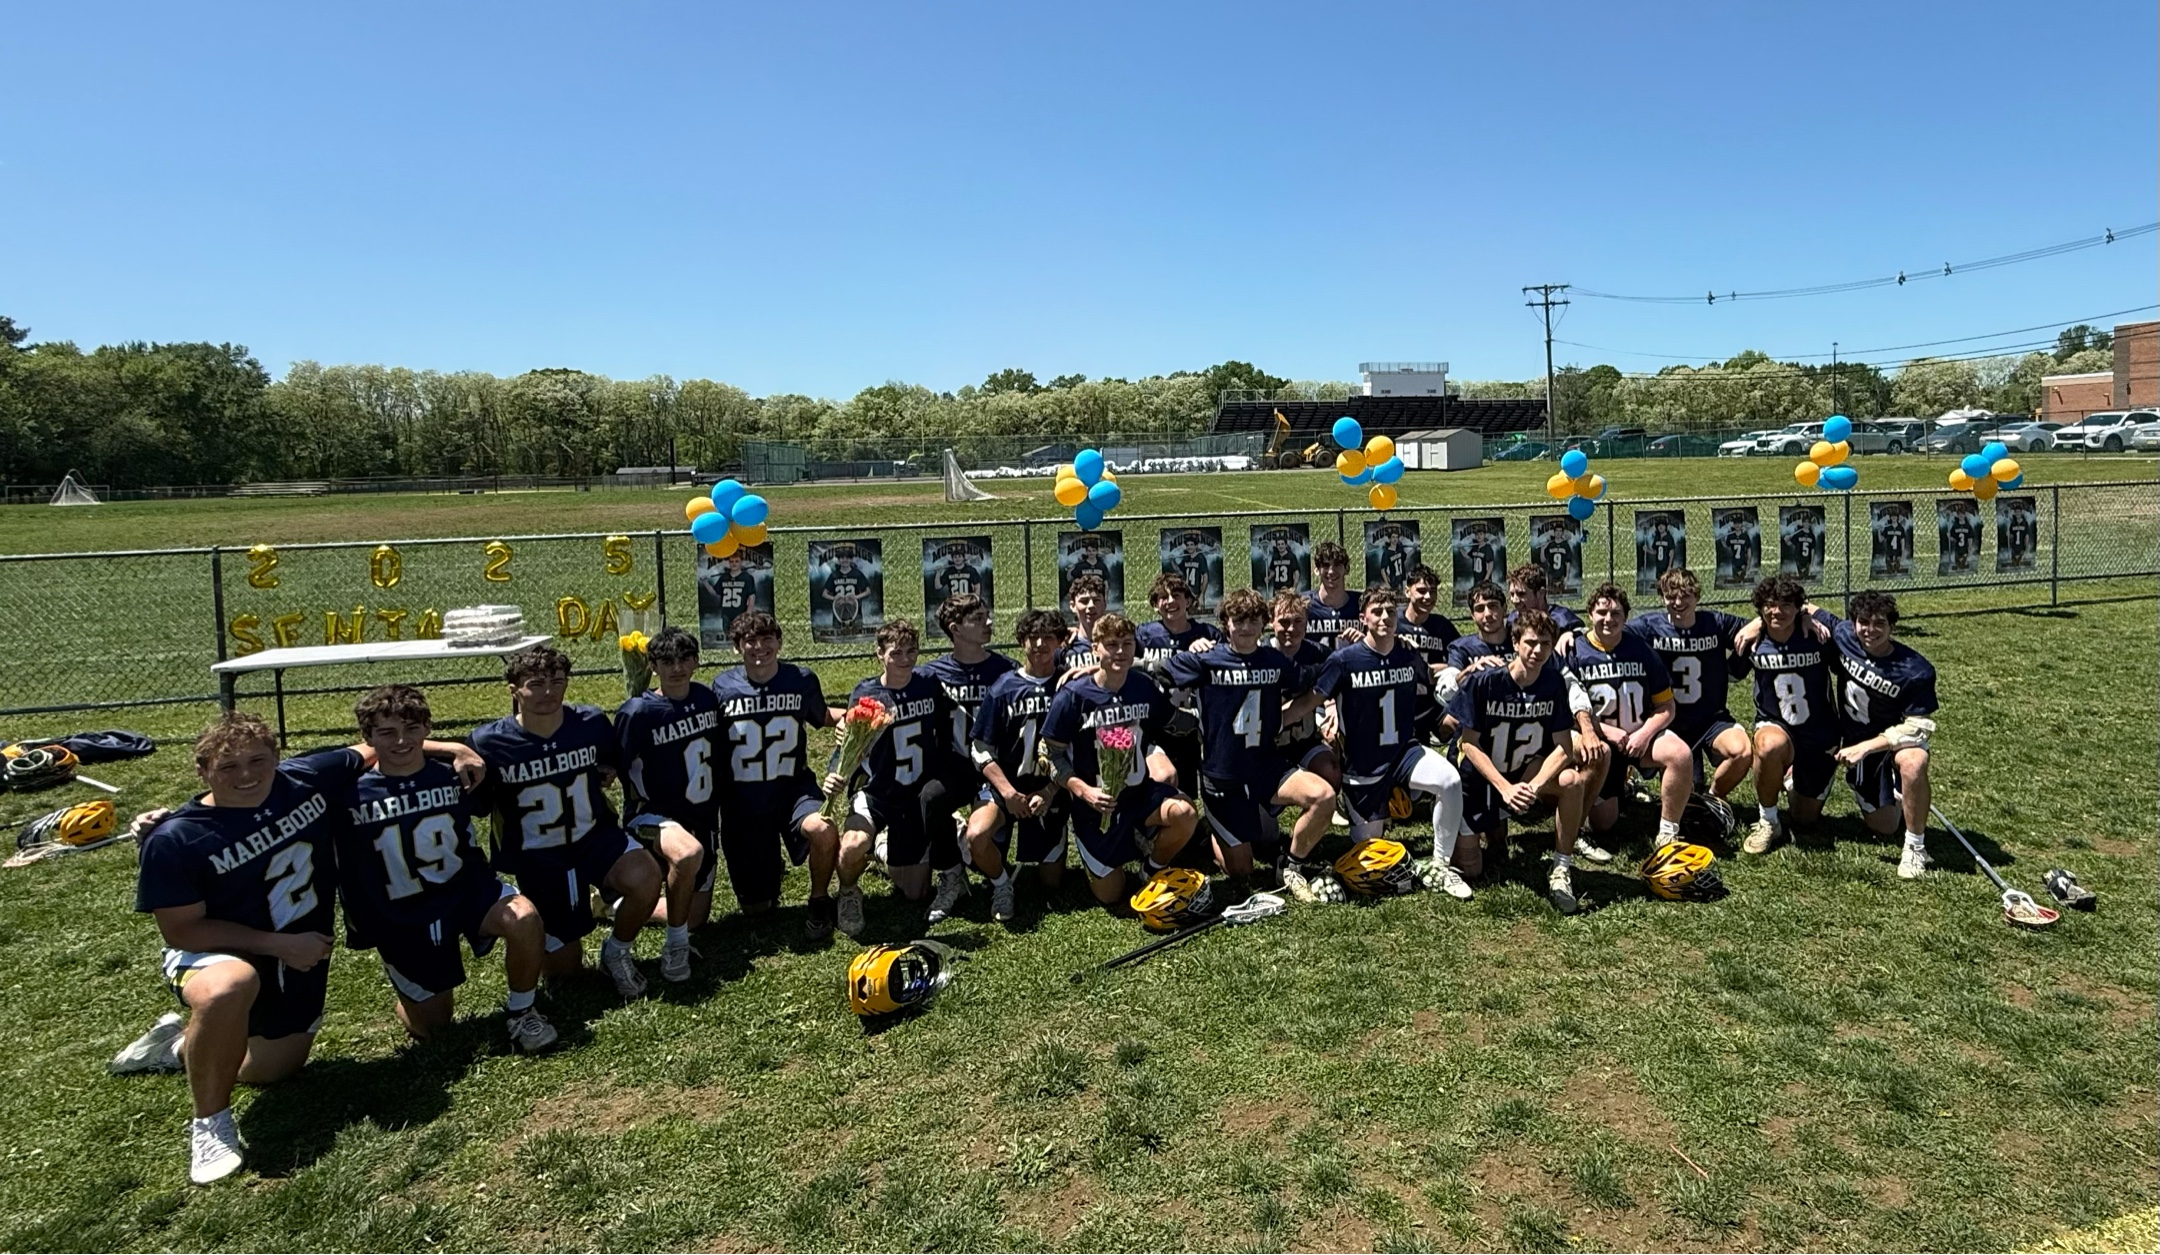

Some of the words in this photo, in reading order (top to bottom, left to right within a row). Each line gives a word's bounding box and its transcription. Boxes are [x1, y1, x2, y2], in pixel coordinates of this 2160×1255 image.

[1733, 544, 1741, 560] 7
[1802, 541, 1809, 557] 5
[1890, 535, 1897, 550] 4
[1958, 532, 1965, 547] 3
[2015, 530, 2021, 545] 1
[1186, 567, 1196, 586] 14
[1275, 566, 1288, 582] 13
[1553, 553, 1562, 570] 9
[722, 588, 742, 608] 25
[950, 580, 969, 595] 20
[1653, 635, 1718, 652] MARLBORO
[1749, 651, 1821, 670] MARLBORO
[1351, 666, 1415, 688] MARLBORO
[1672, 656, 1701, 704] 3
[722, 693, 802, 717] MARLBORO
[1486, 700, 1555, 718] MARLBORO
[1589, 681, 1644, 733] 20
[1774, 672, 1811, 726] 8
[1845, 680, 1870, 725] 9
[1232, 689, 1262, 748] 4
[1379, 689, 1399, 746] 1
[728, 715, 799, 782] 22
[893, 721, 923, 786] 5
[1490, 721, 1543, 774] 12
[501, 745, 597, 783] MARLBORO
[684, 736, 713, 805] 6
[518, 773, 596, 850] 21
[208, 792, 327, 875] MARLBORO
[374, 812, 463, 900] 19
[265, 841, 318, 931] 2
